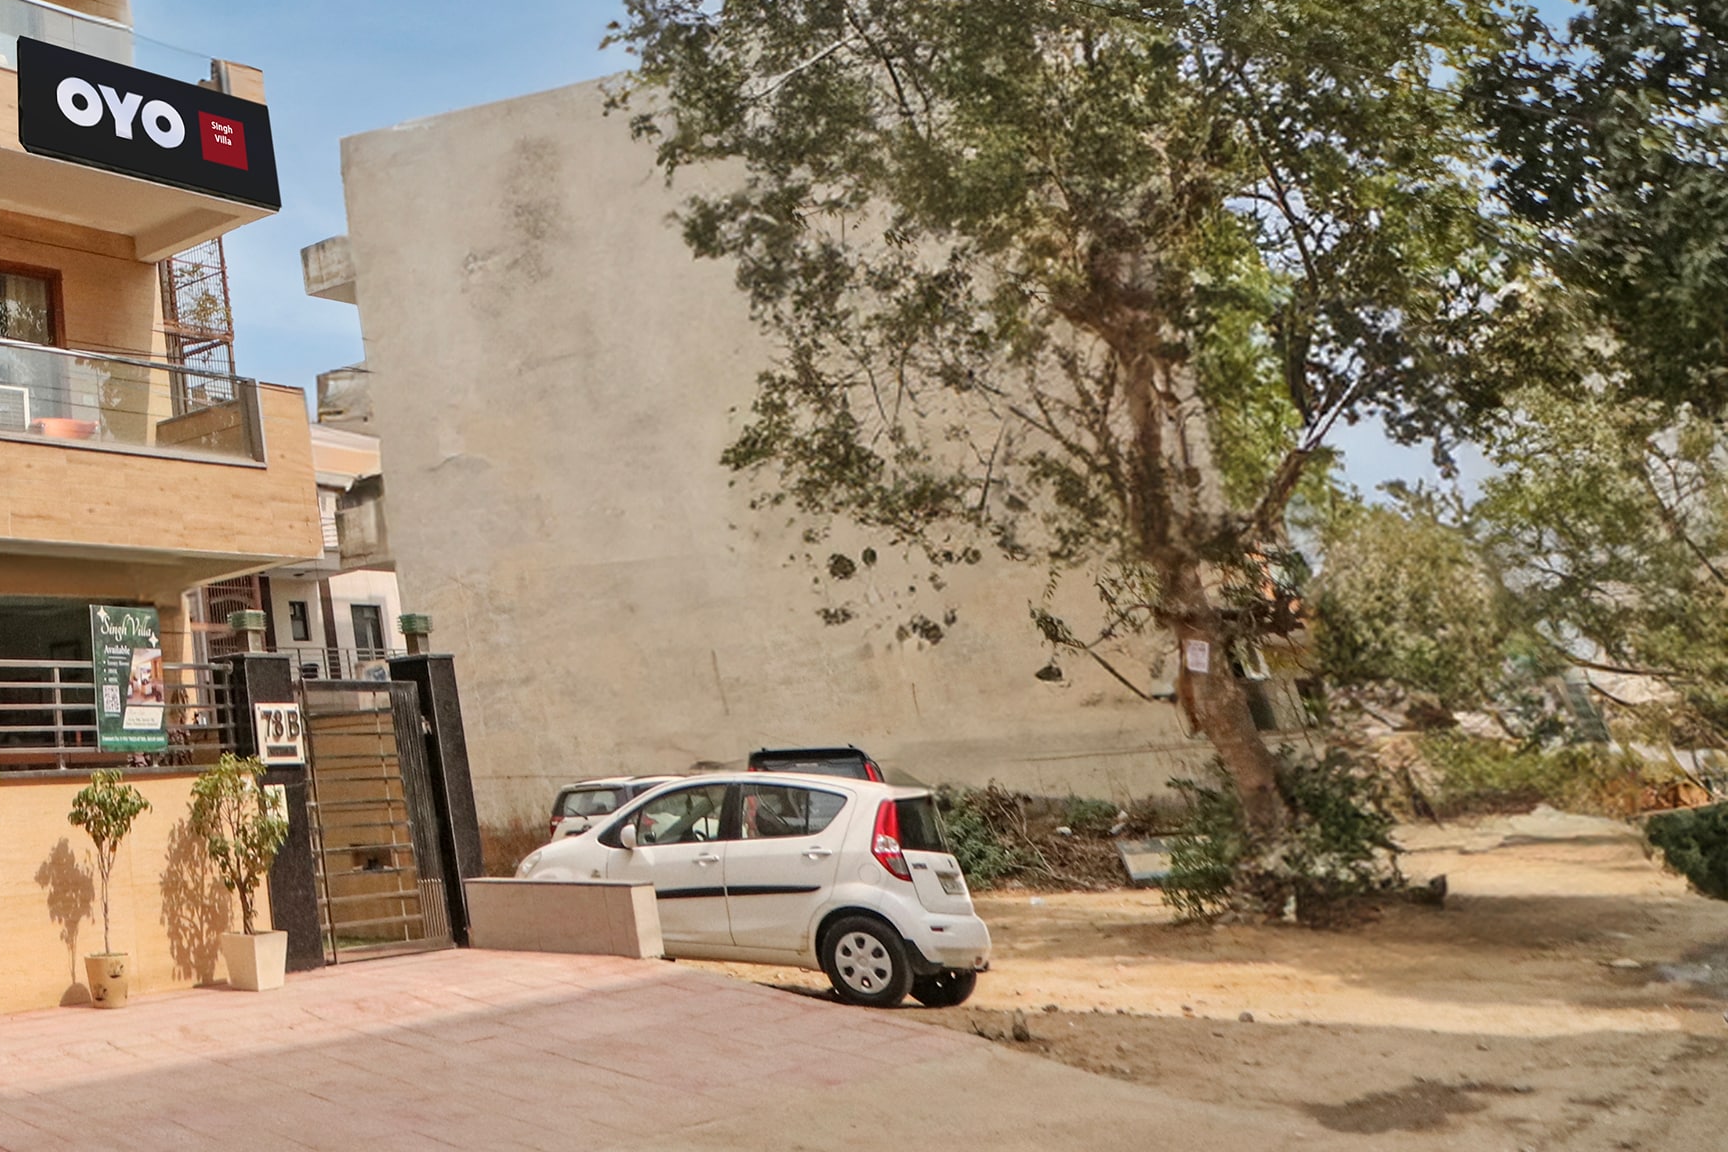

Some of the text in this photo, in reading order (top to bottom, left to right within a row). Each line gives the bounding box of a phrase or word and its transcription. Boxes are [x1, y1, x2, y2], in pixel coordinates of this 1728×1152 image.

[56, 77, 186, 149] OYO
[211, 121, 234, 135] Singh
[214, 133, 233, 146] Villa
[100, 614, 152, 642] Singh Villa
